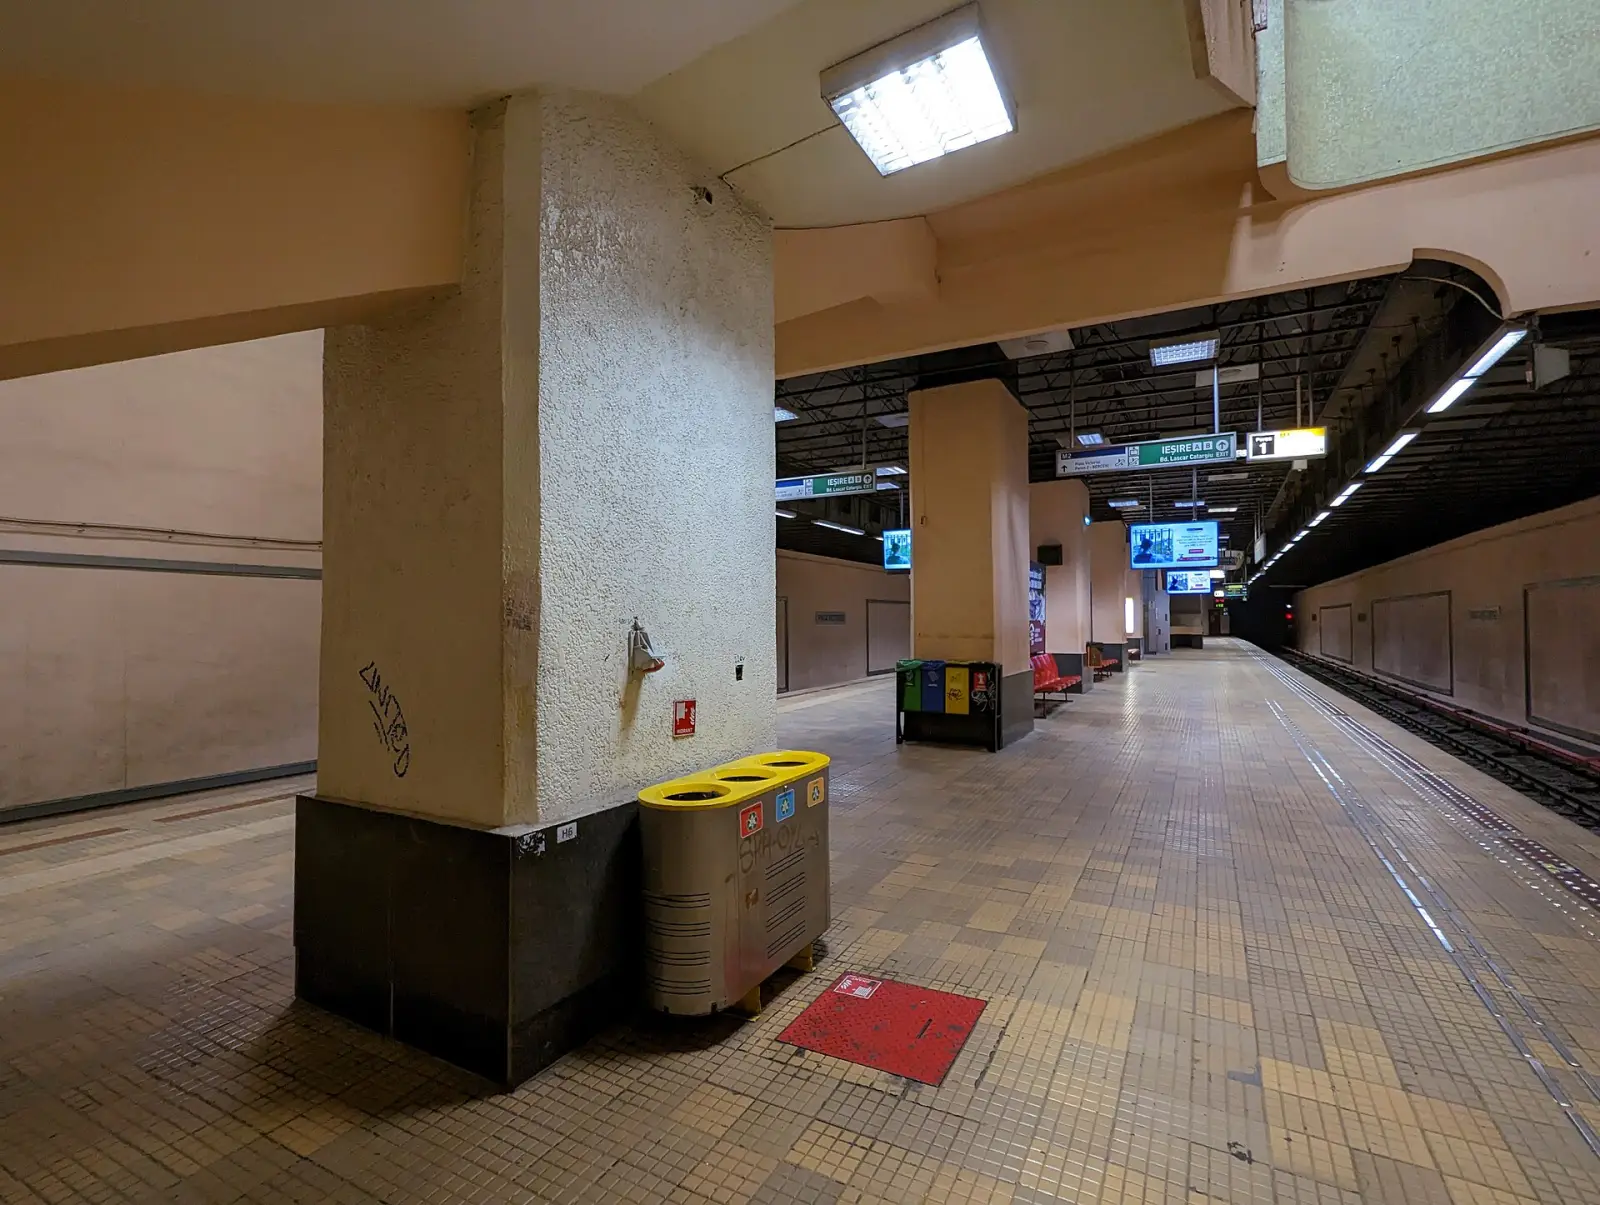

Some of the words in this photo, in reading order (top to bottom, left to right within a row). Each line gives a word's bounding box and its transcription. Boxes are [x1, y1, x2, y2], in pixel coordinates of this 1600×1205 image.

[1161, 443, 1192, 455] IEȘIRE
[1259, 442, 1266, 454] 1
[1189, 452, 1214, 460] Catargiu
[827, 477, 848, 487] IEȘIRE
[561, 827, 573, 839] H6
